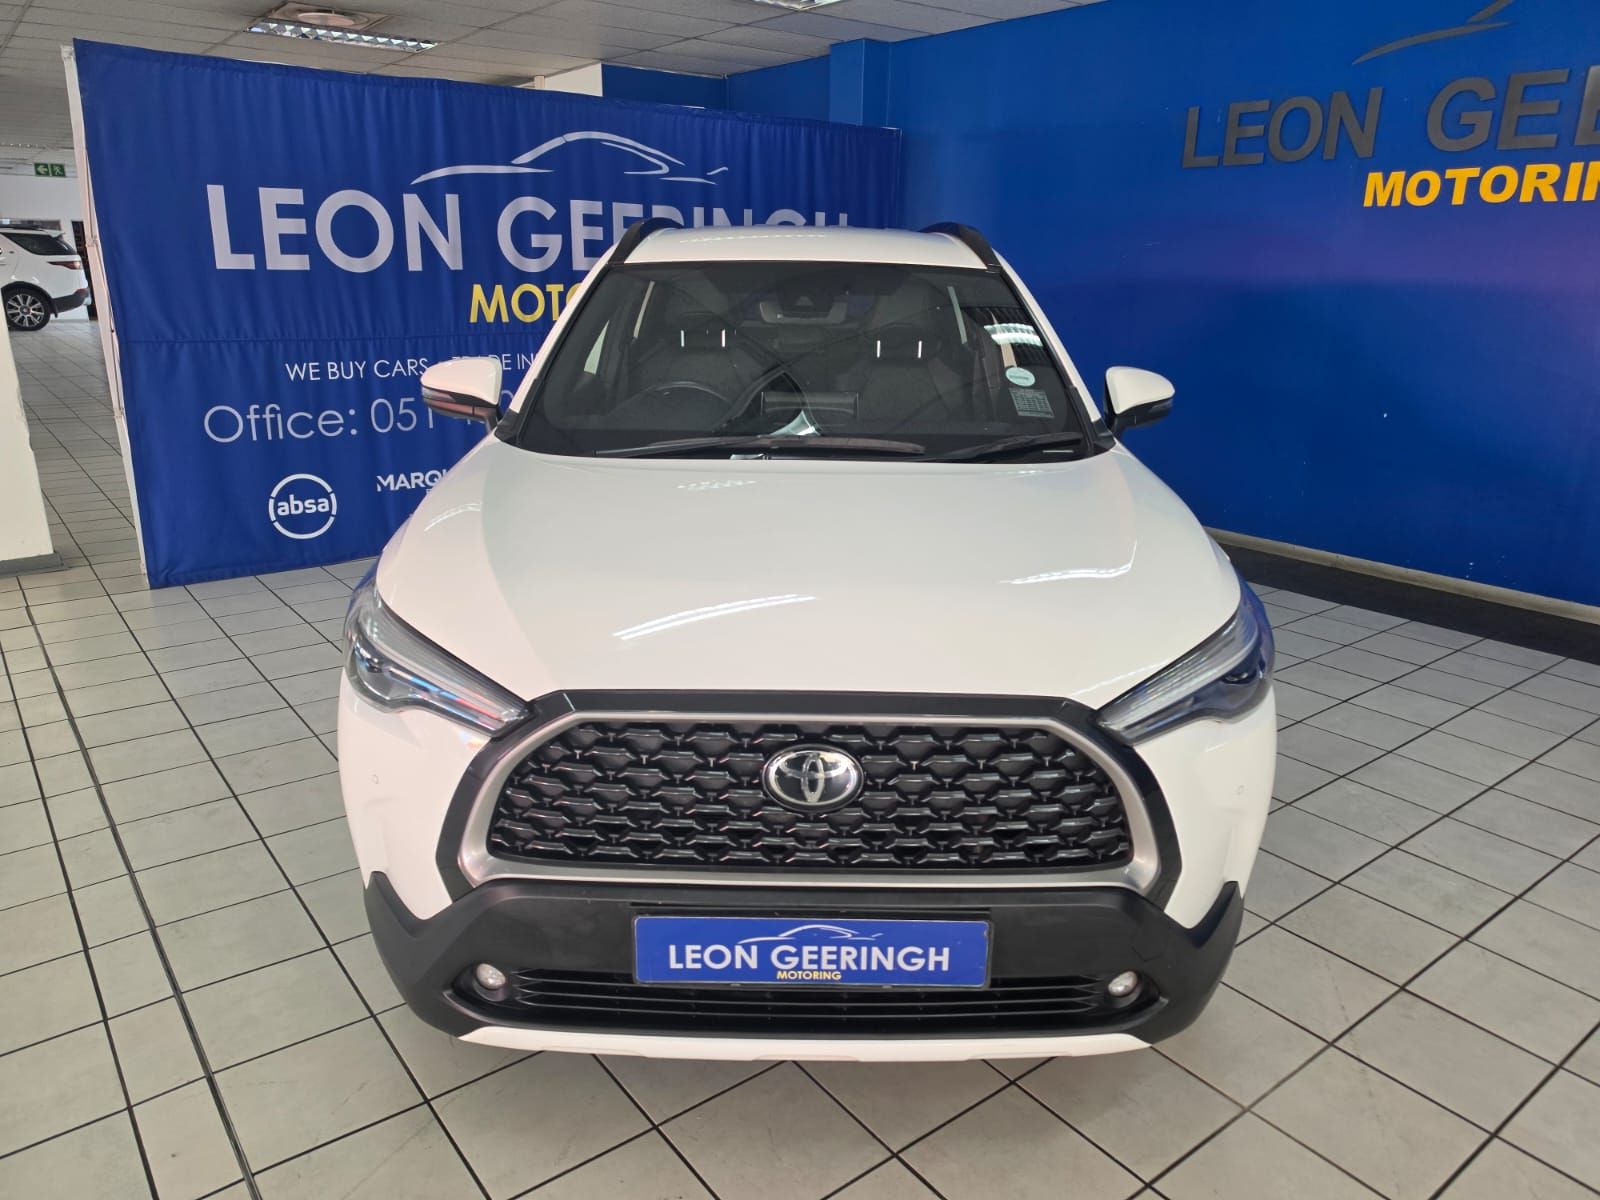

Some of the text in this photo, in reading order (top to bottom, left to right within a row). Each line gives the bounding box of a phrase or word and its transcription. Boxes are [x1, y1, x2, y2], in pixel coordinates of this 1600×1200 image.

[1182, 64, 1600, 169] LEON GE
[206, 184, 463, 273] LEON
[286, 362, 320, 382] WE
[327, 360, 367, 380] BUY
[373, 358, 429, 379] CARS
[204, 403, 358, 443] Office:
[277, 494, 330, 516] absa
[668, 944, 950, 971] LEON GEERINGH
[776, 970, 842, 981] MOTORING
